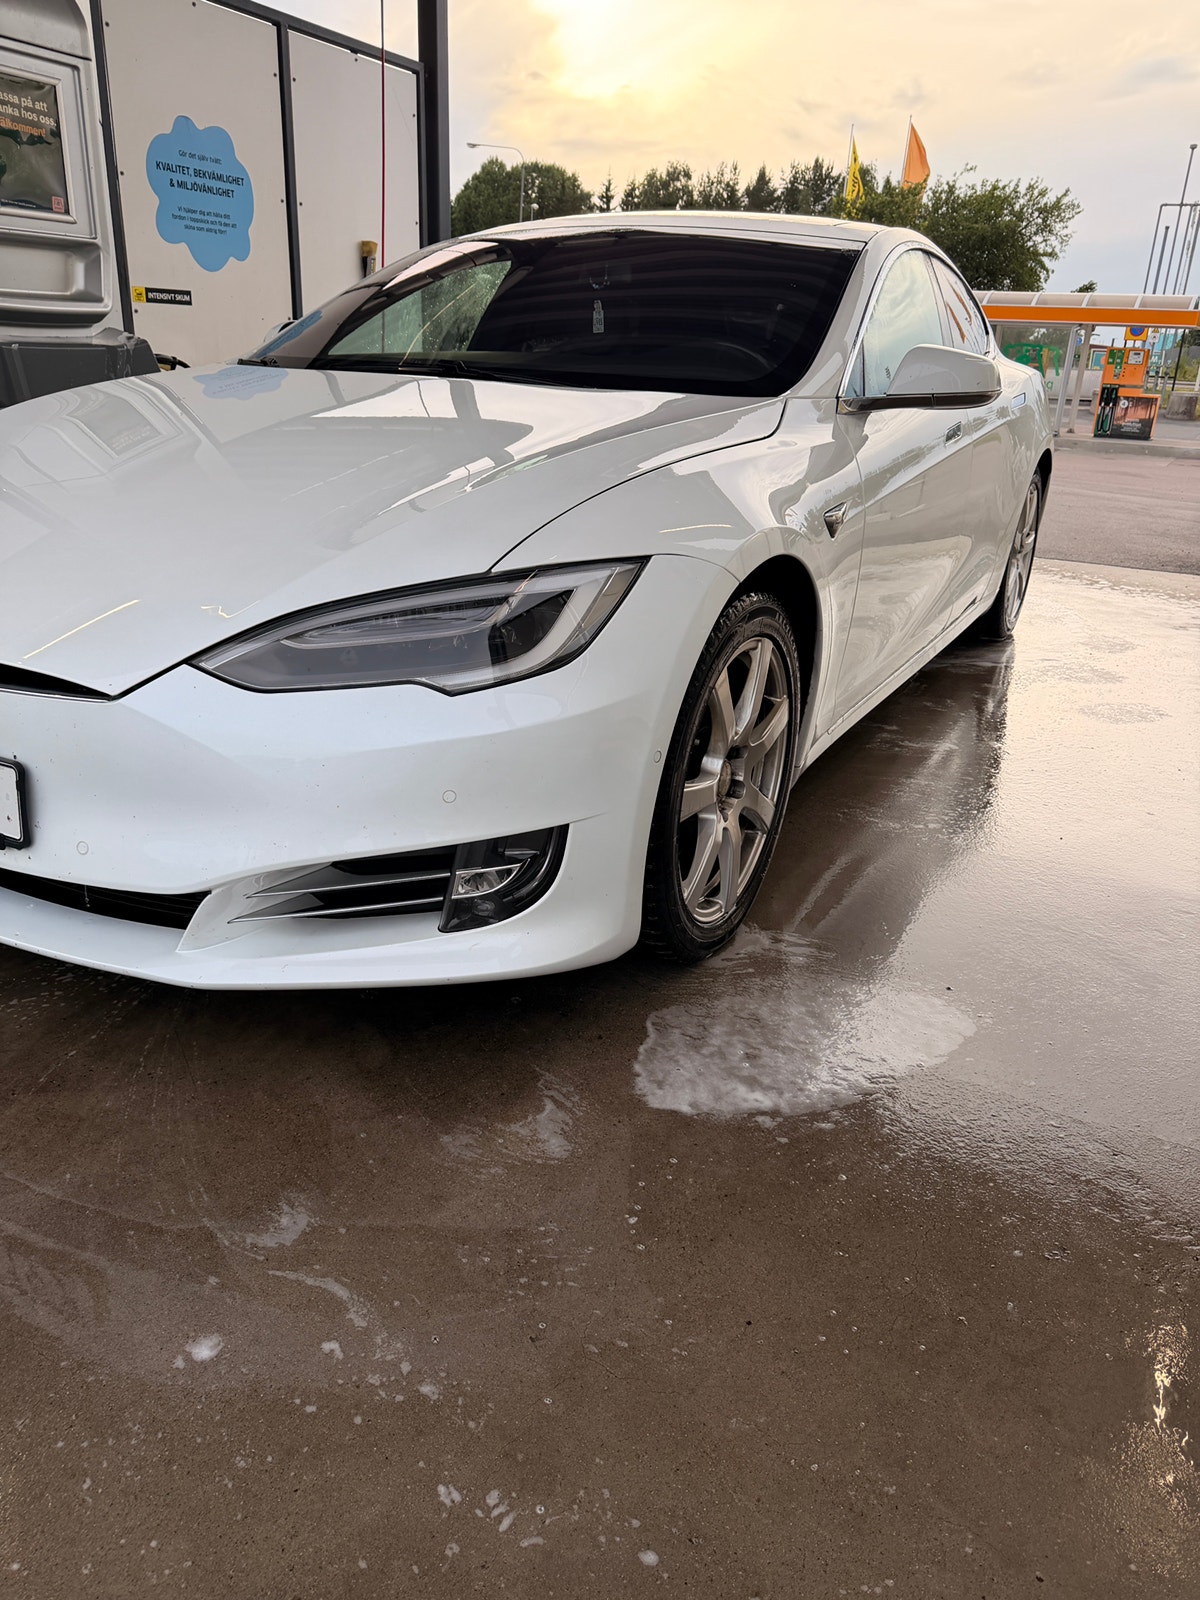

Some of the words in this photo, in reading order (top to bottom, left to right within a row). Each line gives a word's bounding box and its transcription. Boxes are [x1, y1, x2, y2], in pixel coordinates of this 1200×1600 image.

[21, 96, 33, 108] på
[34, 101, 48, 112] att
[21, 108, 38, 121] hos
[39, 115, 57, 126] oss.
[188, 152, 197, 160] det
[156, 161, 192, 177] KVALITET,
[193, 168, 244, 186] BEKVÄMLIGHET
[169, 178, 175, 188] &
[176, 179, 235, 198] MILJÖVÄNLIGHET
